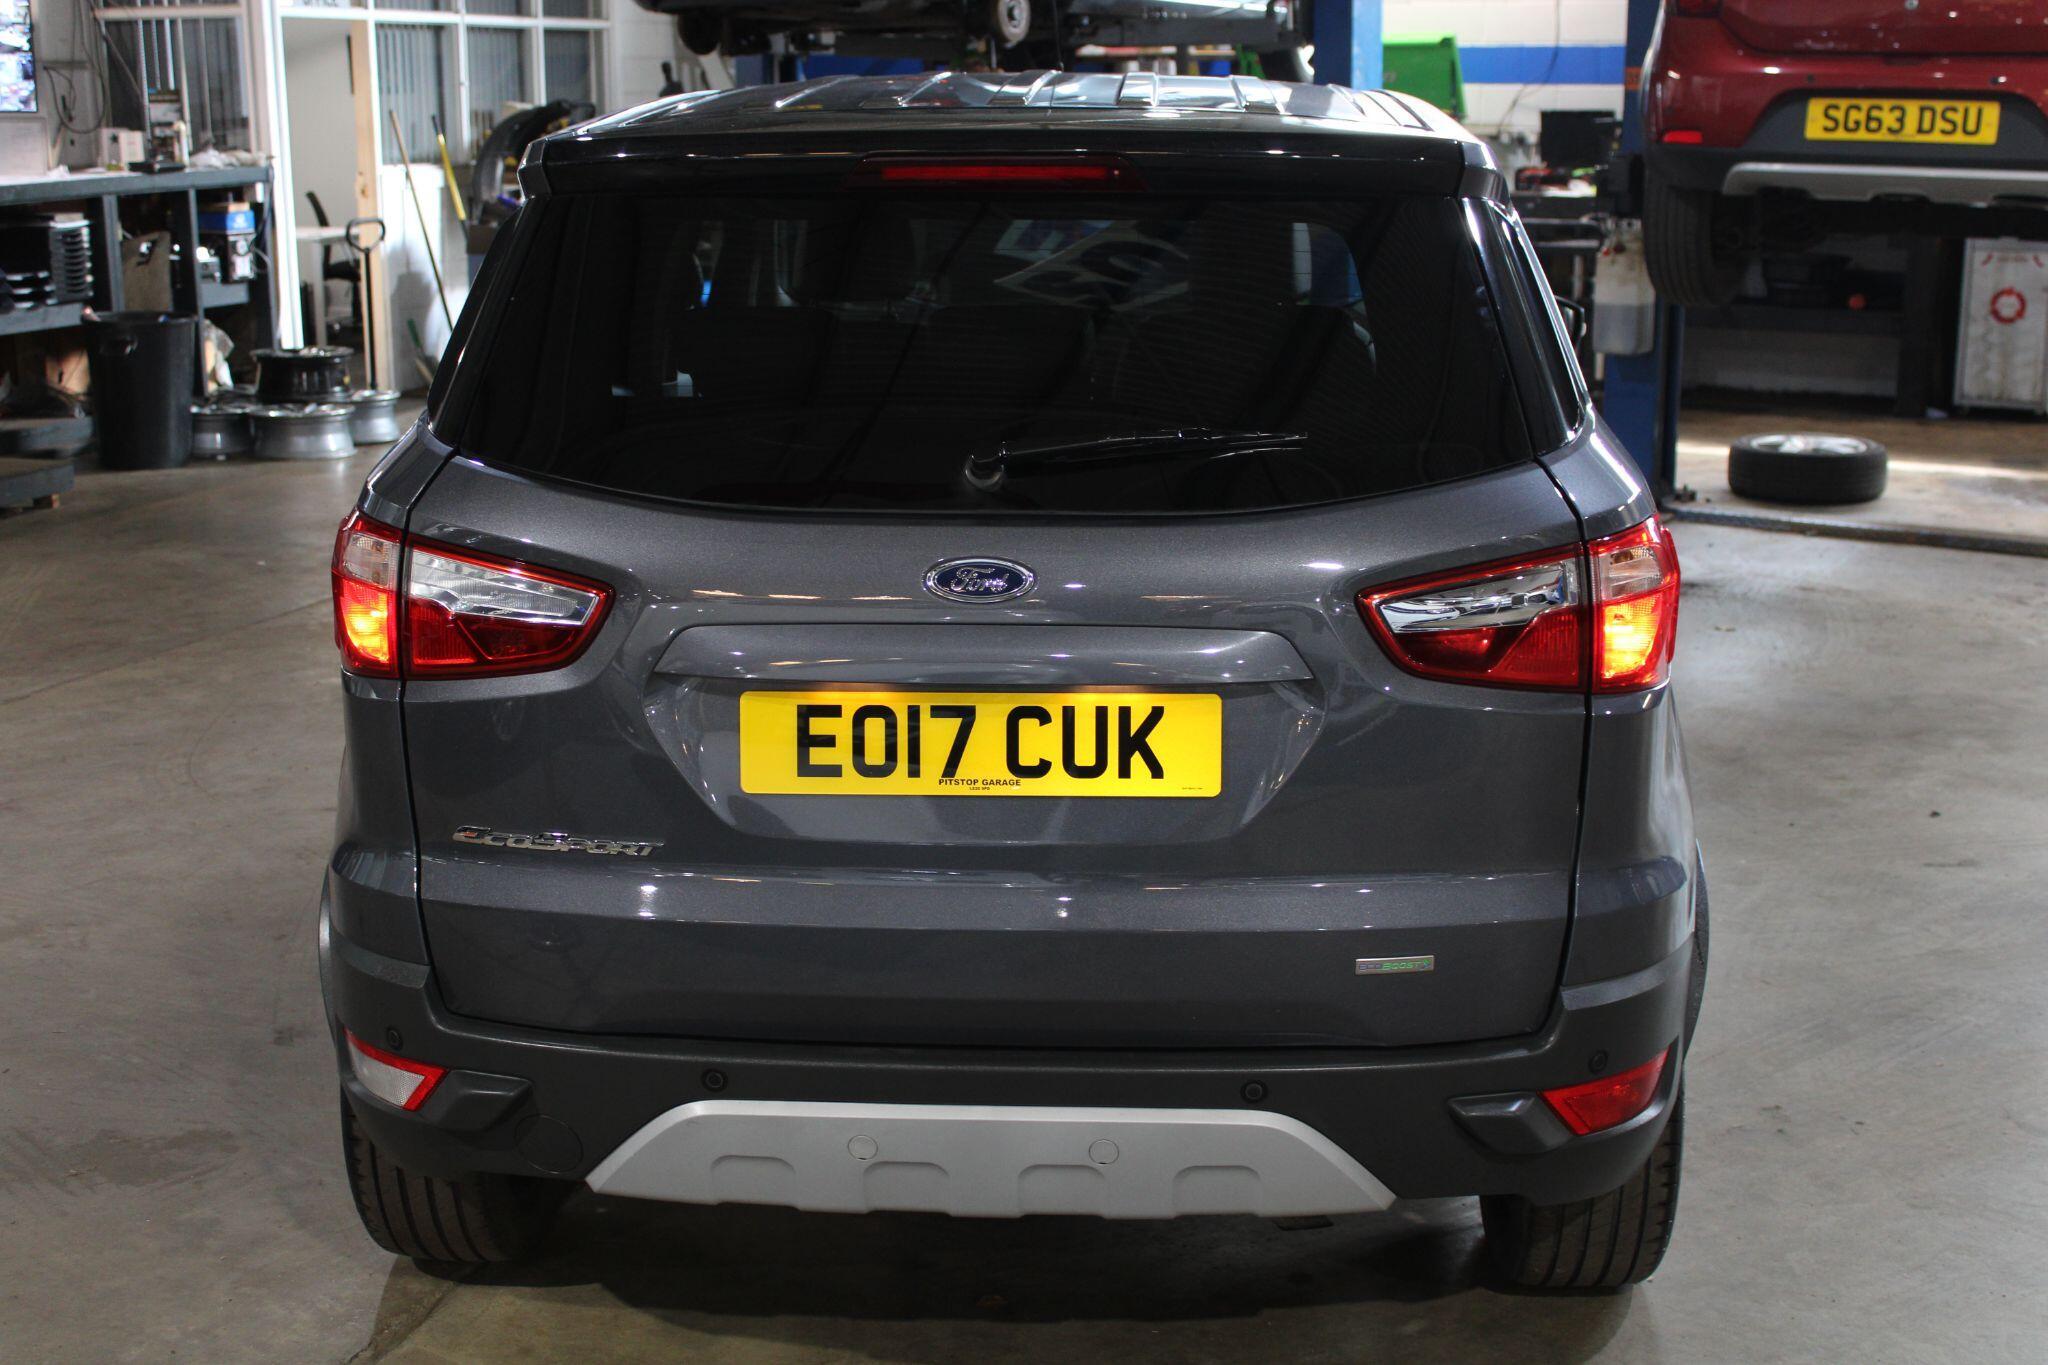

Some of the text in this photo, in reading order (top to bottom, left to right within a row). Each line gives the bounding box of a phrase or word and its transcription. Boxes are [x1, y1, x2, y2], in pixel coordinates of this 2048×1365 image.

[1822, 102, 1984, 136] SG63 DSU
[950, 567, 1010, 593] Ford
[796, 704, 1165, 780] EO17 CUK
[938, 778, 1022, 787] PITSTOP GARAGE
